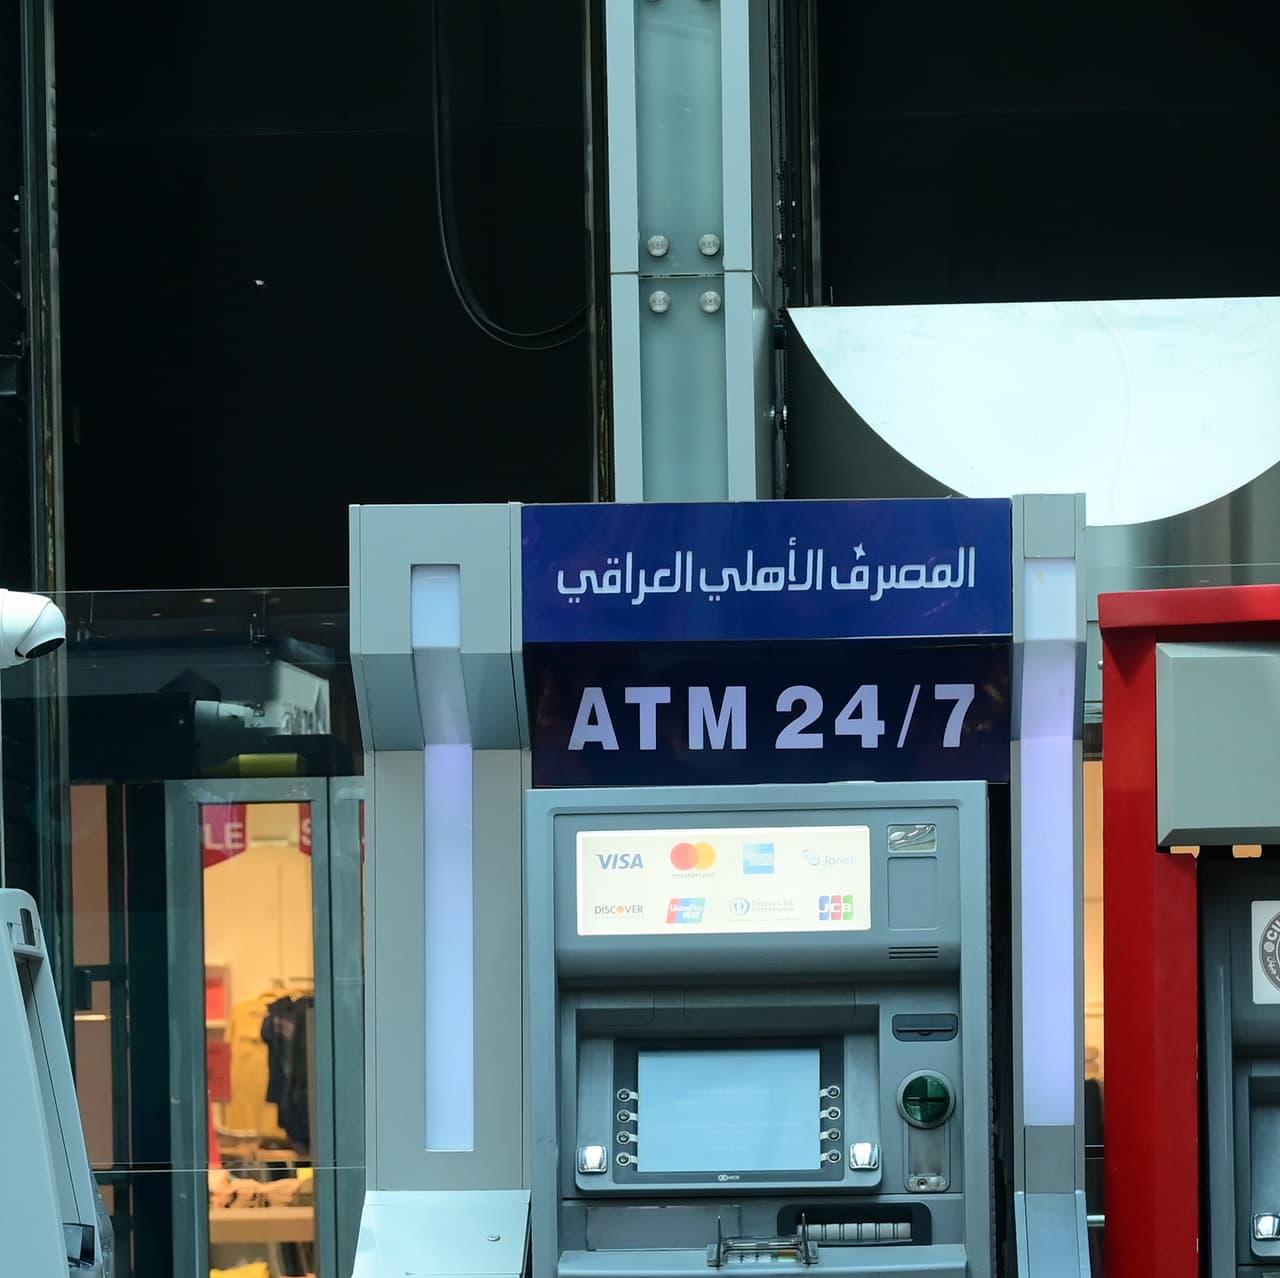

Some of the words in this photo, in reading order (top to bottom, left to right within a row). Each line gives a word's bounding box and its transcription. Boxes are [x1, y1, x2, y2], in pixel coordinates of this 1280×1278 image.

[556, 550, 694, 605] العراقي
[699, 536, 824, 602] الأهلي
[830, 542, 976, 602] المصرف
[568, 686, 747, 751] ATM
[774, 684, 976, 750] 24/7
[597, 853, 644, 870] VISA
[594, 905, 644, 914] DISCOVER
